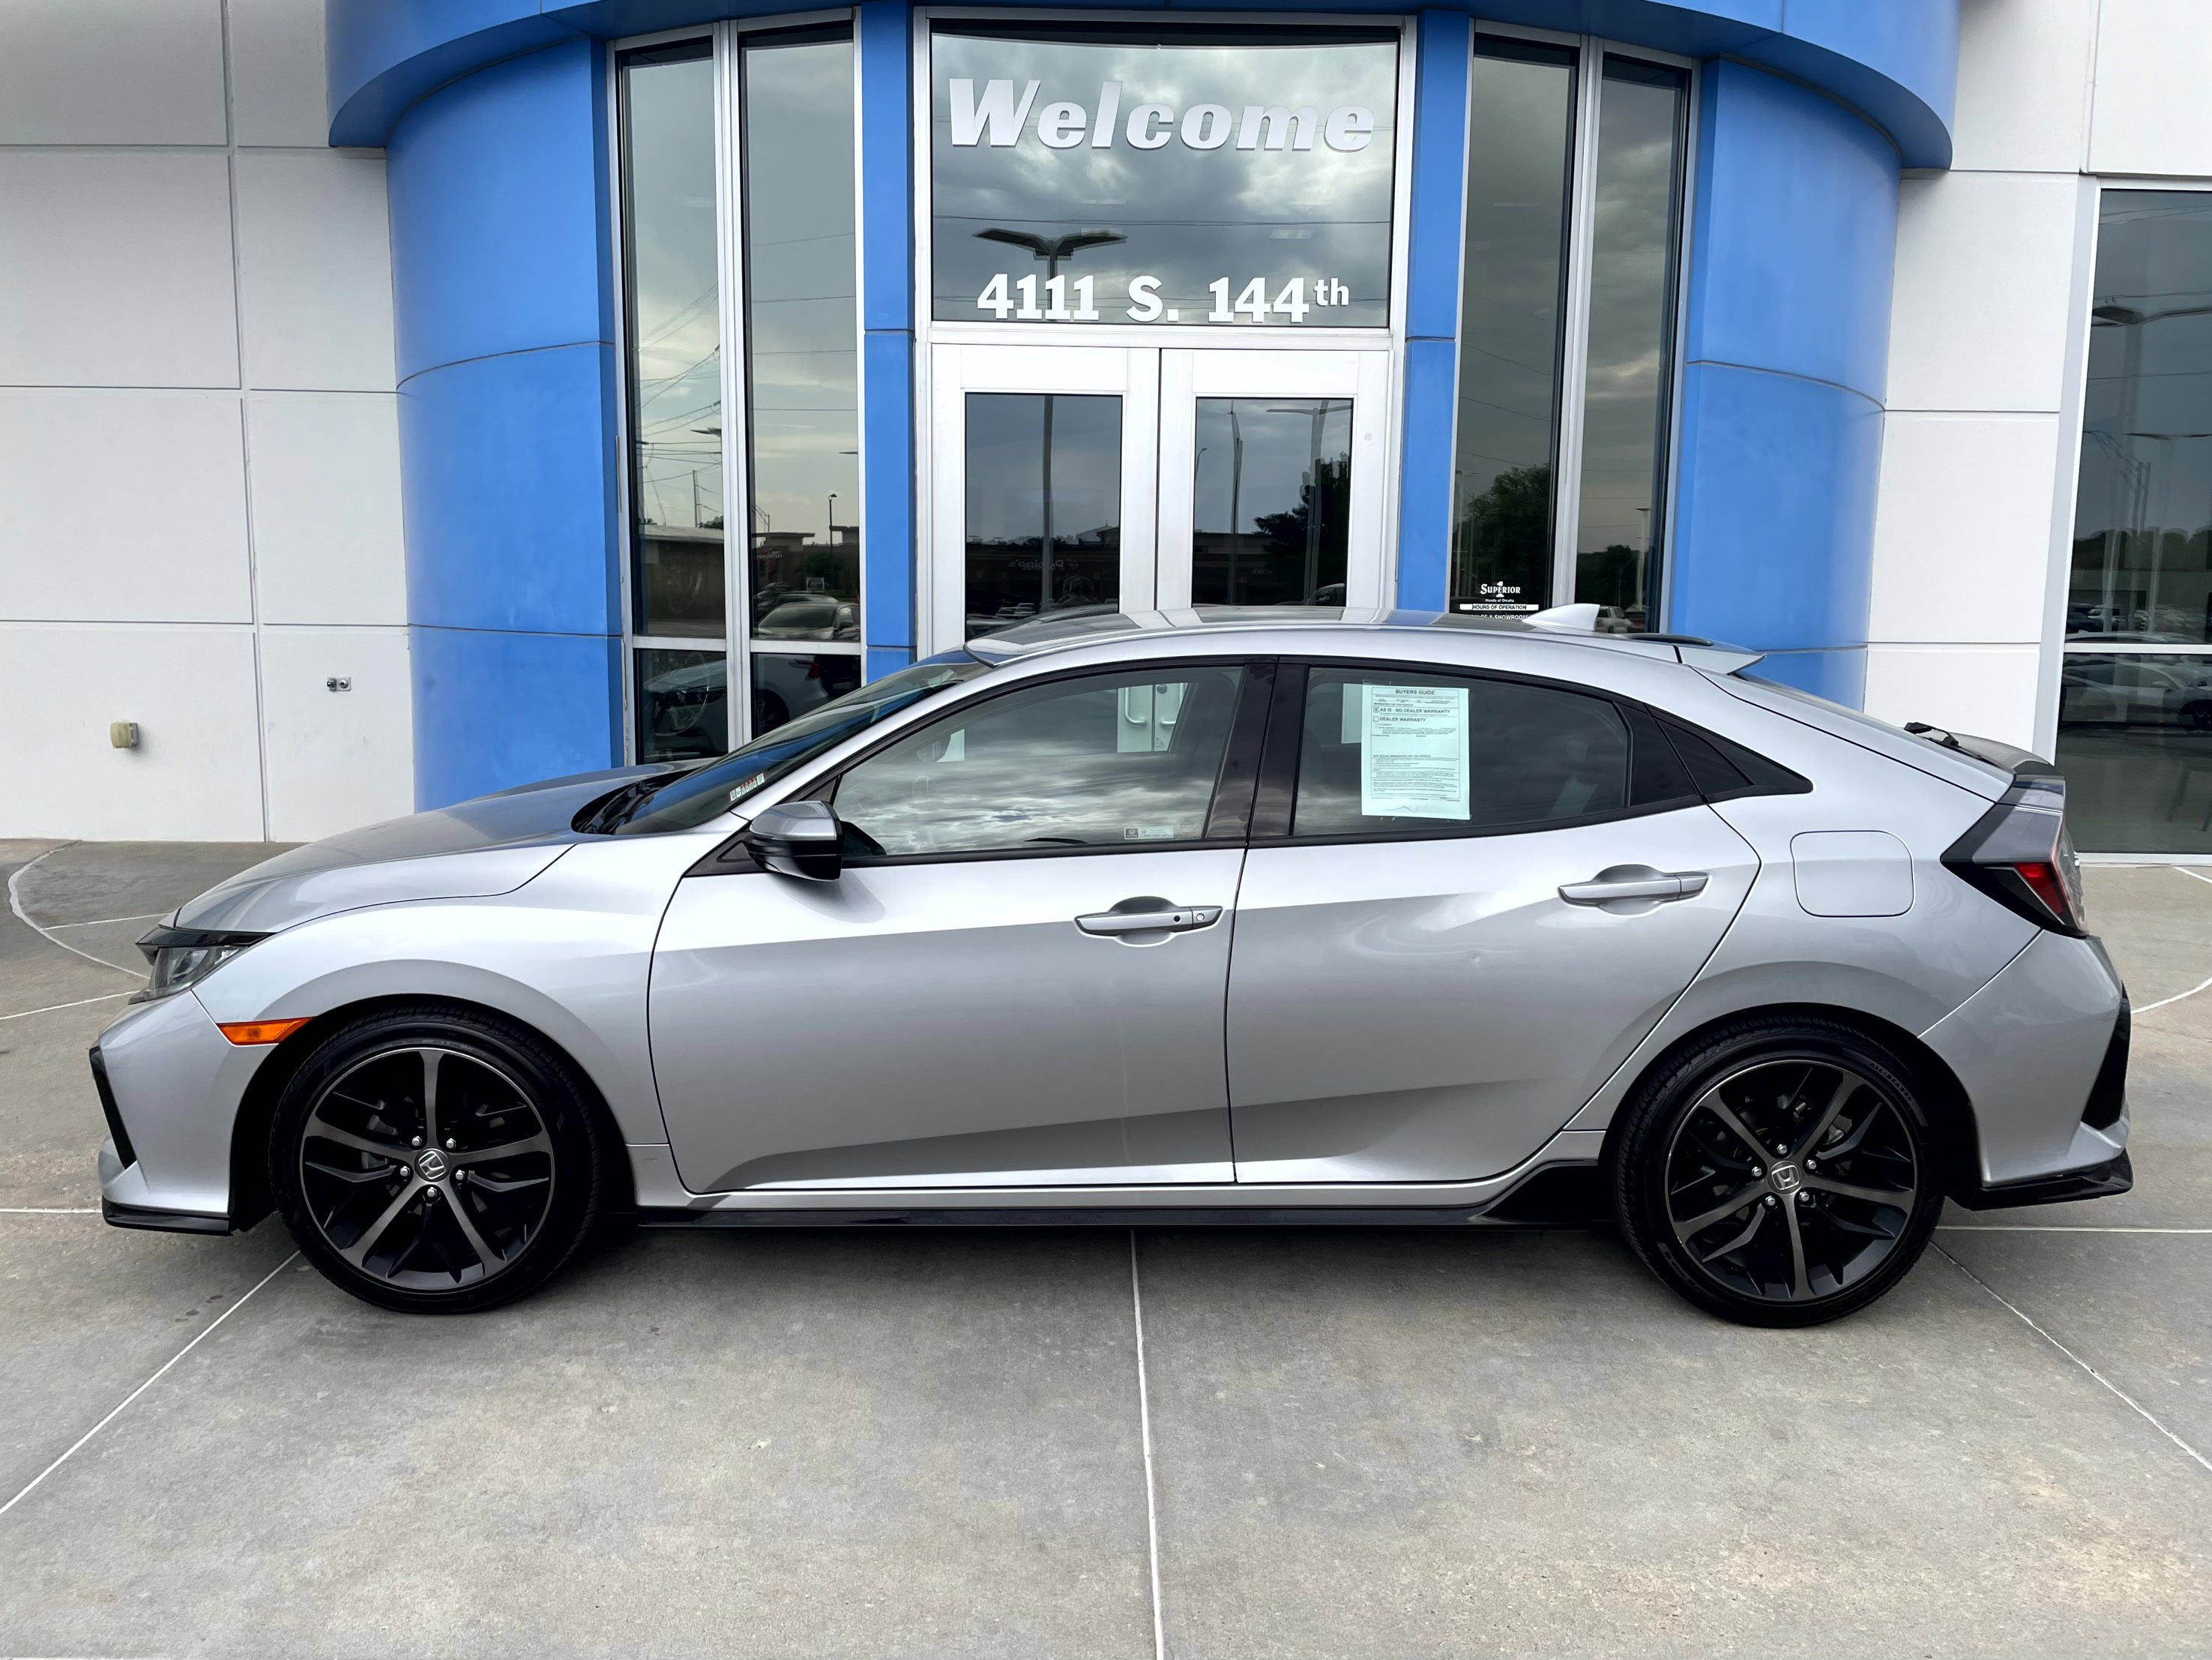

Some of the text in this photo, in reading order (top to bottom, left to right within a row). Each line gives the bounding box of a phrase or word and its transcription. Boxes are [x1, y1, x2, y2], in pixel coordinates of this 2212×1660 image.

[949, 78, 1375, 152] Welcome
[976, 273, 1350, 323] 4111 S. 144th
